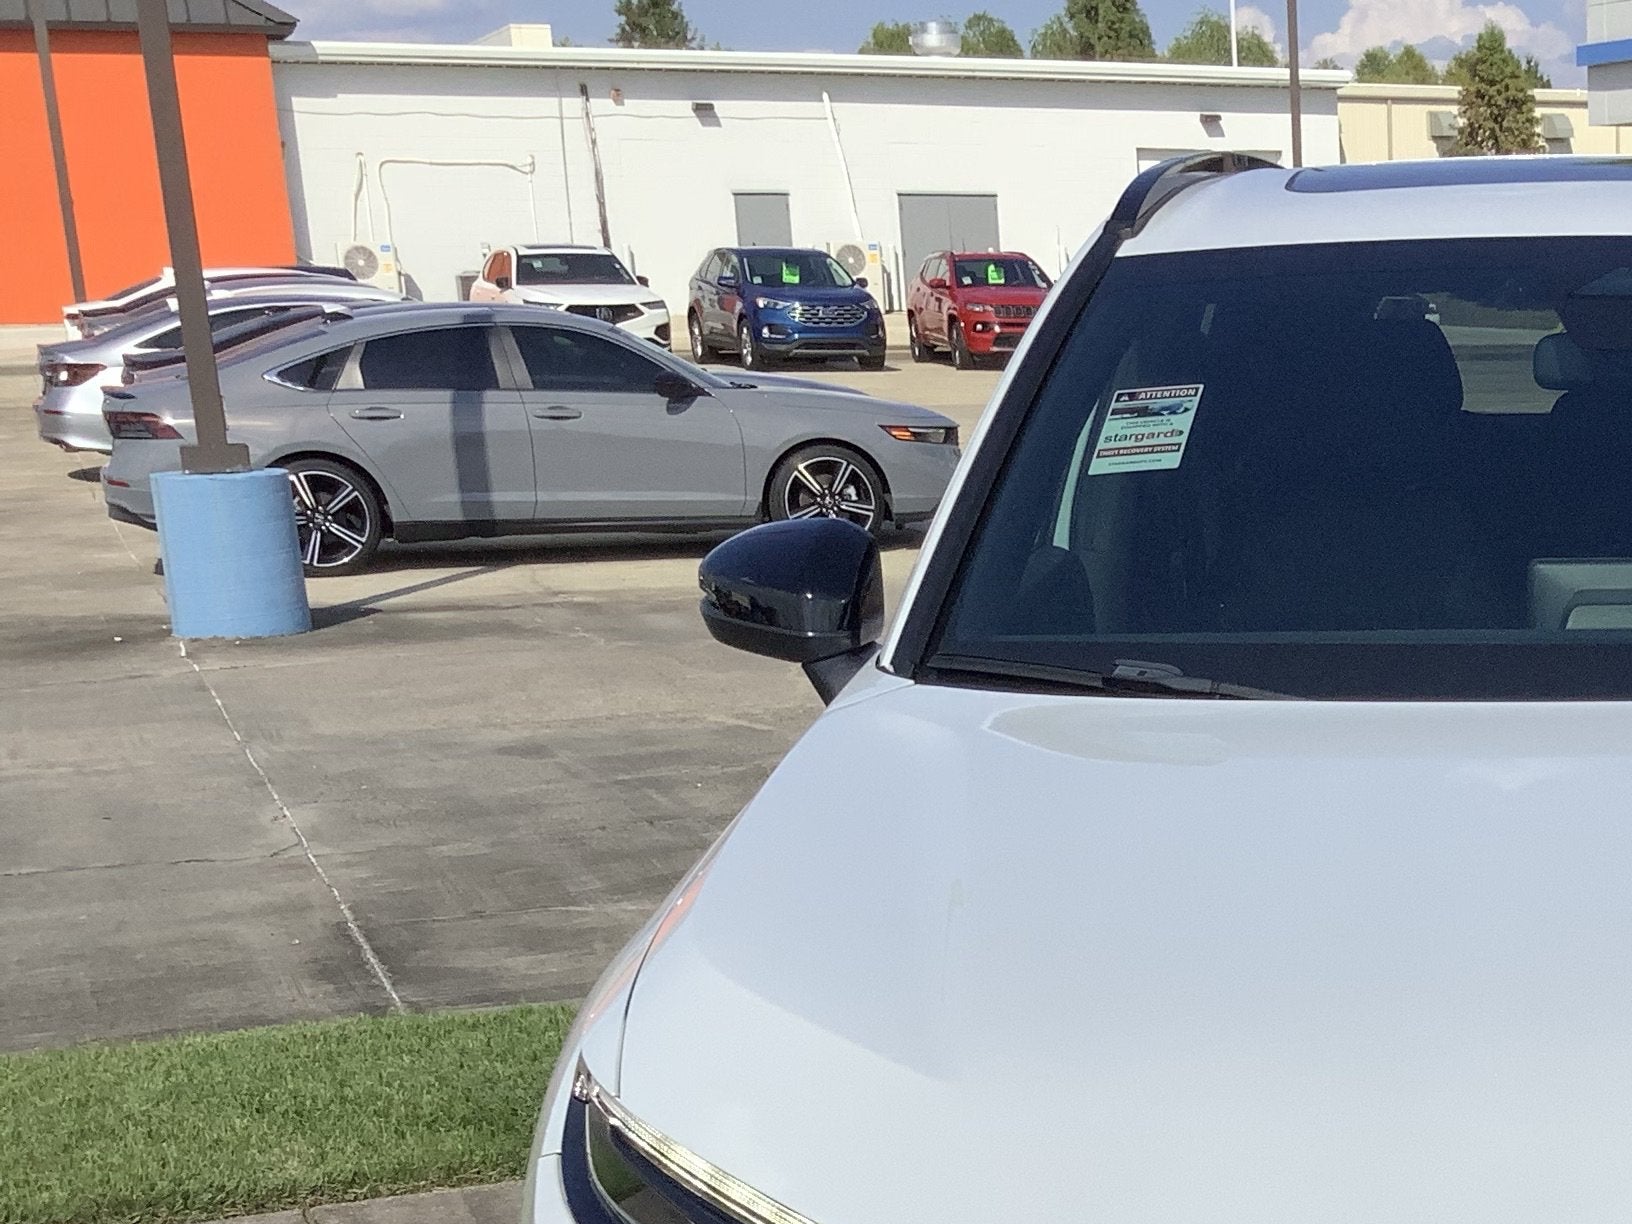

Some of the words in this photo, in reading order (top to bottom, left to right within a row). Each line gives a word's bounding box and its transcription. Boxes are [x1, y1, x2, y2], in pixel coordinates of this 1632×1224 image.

[1139, 388, 1196, 400] ATTENTION
[1120, 446, 1152, 455] RECOVERY
[1153, 444, 1179, 452] SYSTEM
